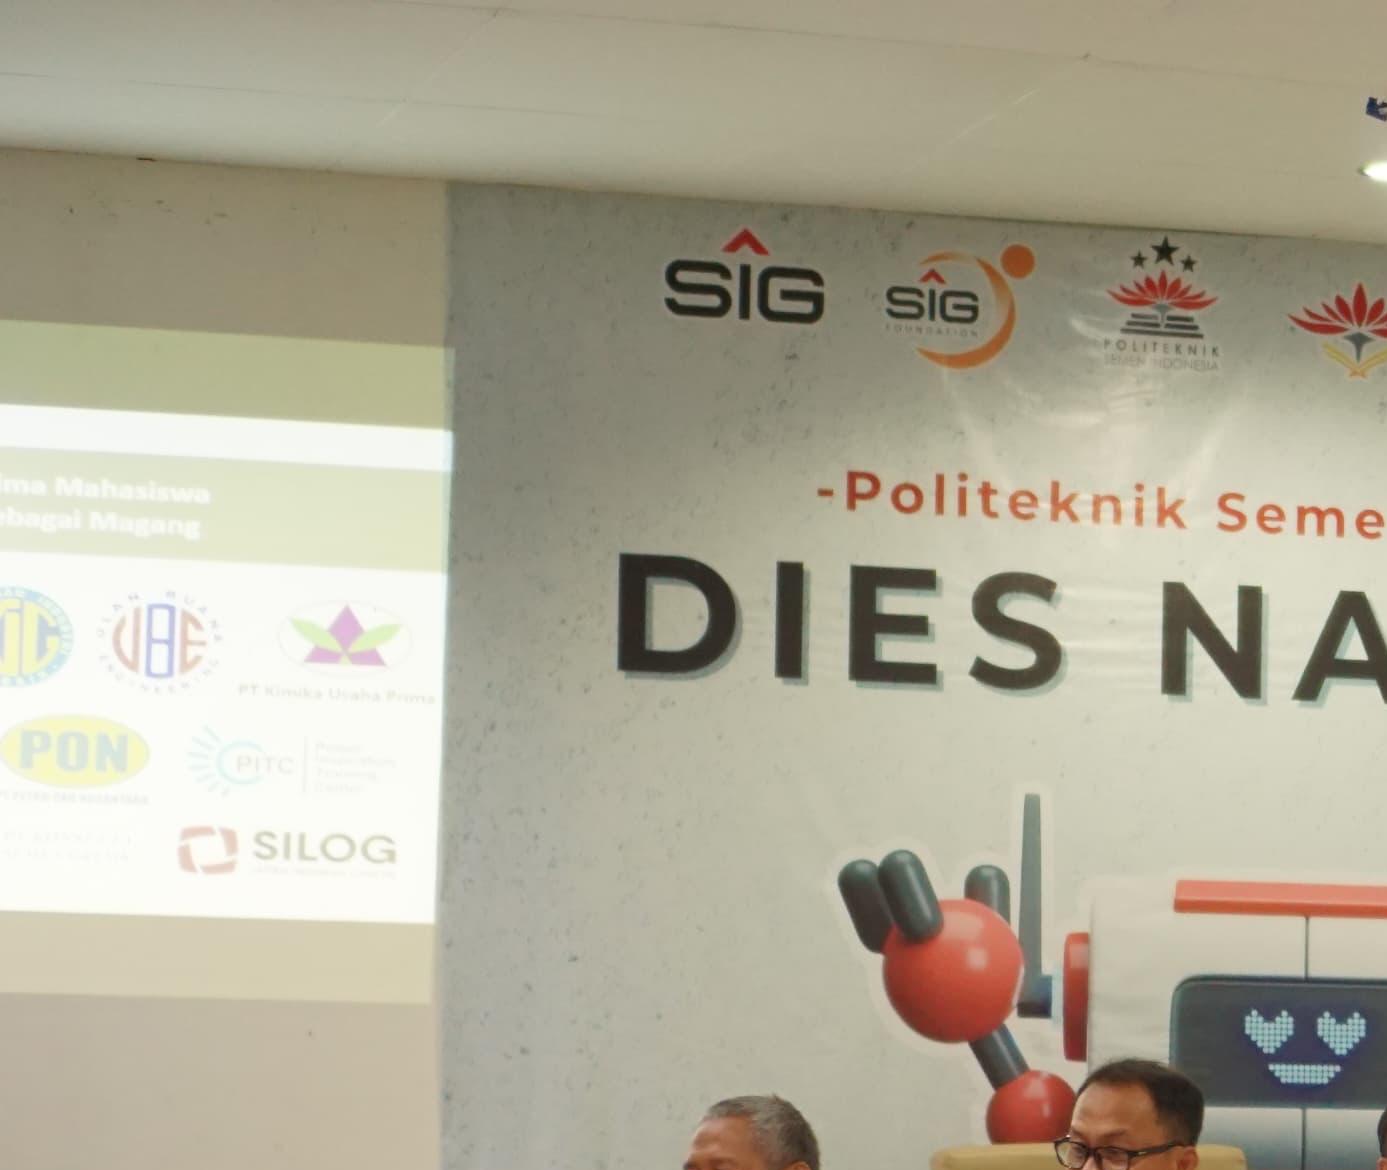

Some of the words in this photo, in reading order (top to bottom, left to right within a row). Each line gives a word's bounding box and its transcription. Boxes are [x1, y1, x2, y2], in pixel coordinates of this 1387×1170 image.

[665, 258, 825, 325] SIG
[886, 285, 979, 324] SIG
[1103, 338, 1220, 358] POLITEKNIK
[55, 475, 212, 505] Mahasiswa
[89, 509, 202, 541] Magang
[618, 552, 1067, 694] DIES
[20, 730, 129, 773] PON
[237, 754, 294, 776] PITC
[252, 830, 397, 865] SILOG
